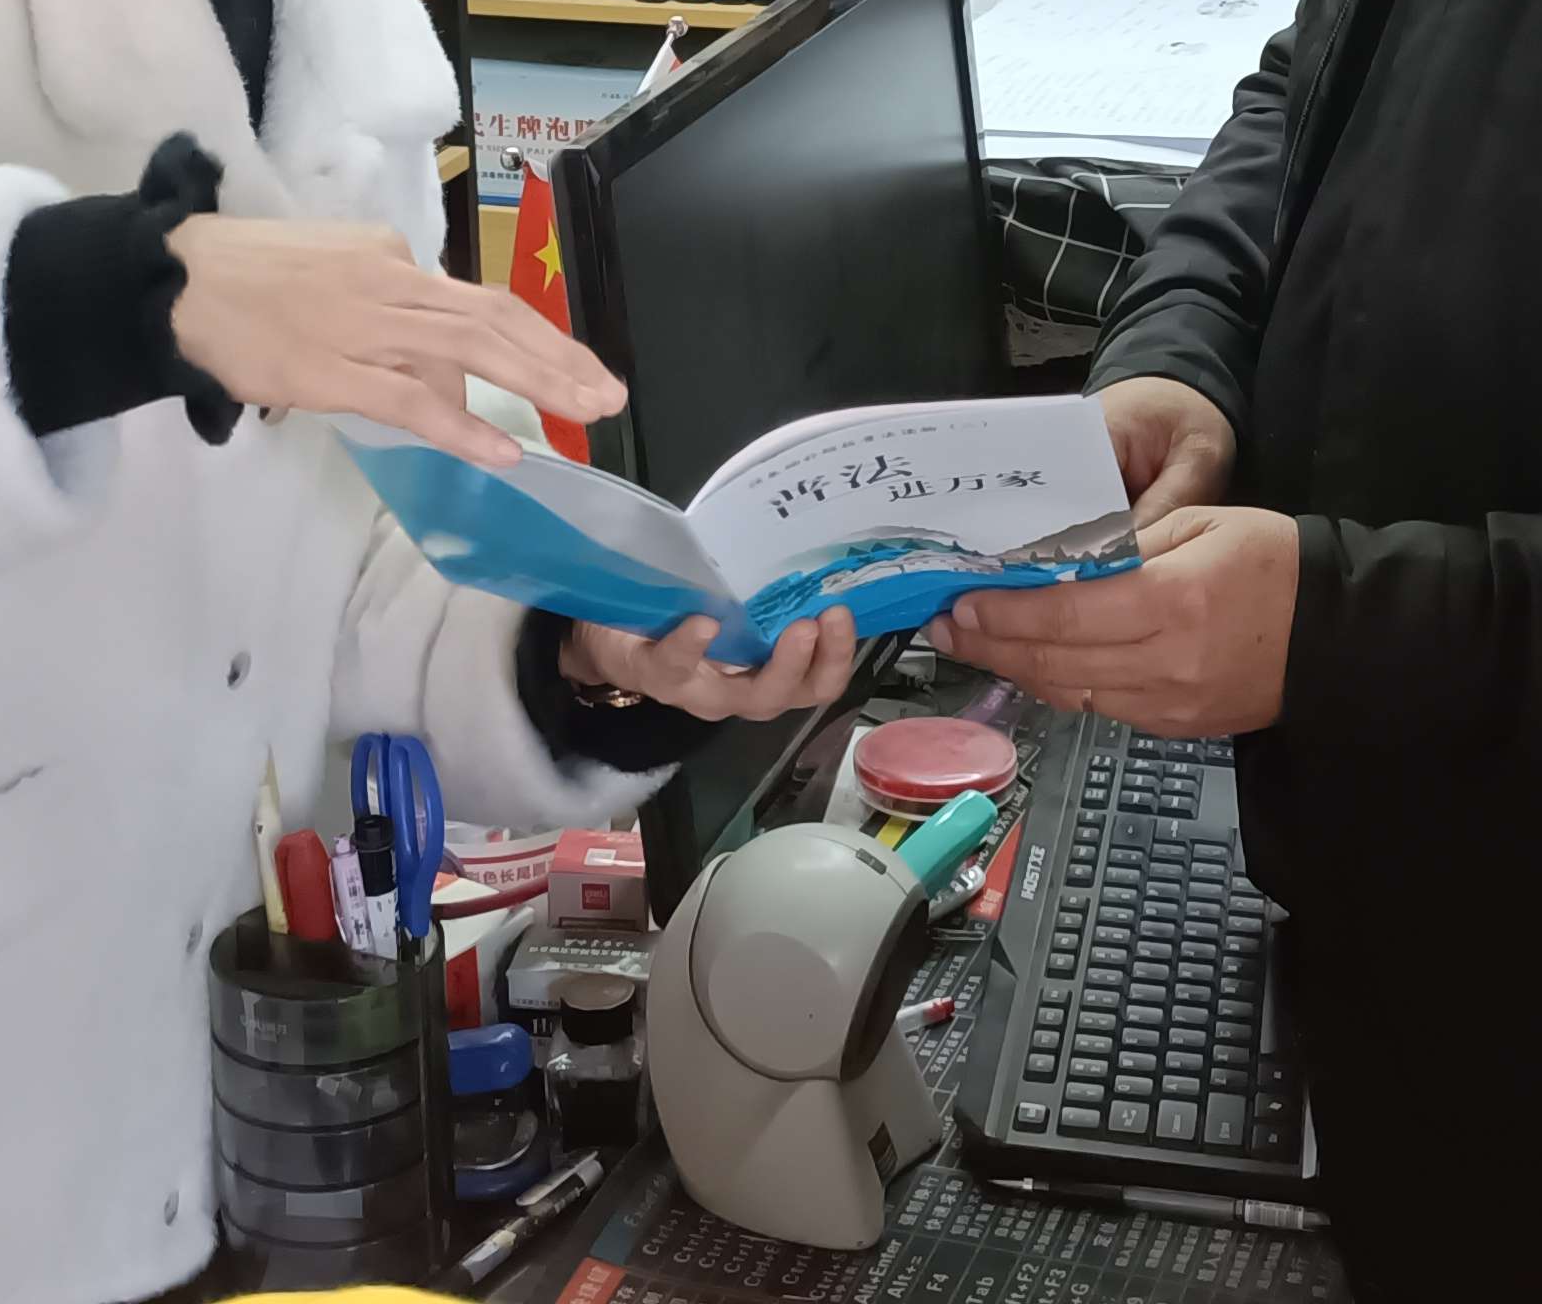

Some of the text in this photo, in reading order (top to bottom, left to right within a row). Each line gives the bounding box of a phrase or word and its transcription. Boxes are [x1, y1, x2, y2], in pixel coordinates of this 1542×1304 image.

[888, 469, 1049, 503] 进万家
[853, 1238, 902, 1304] Alt+Enter
[925, 1272, 950, 1292] F4
[965, 1276, 995, 1304] Tab
